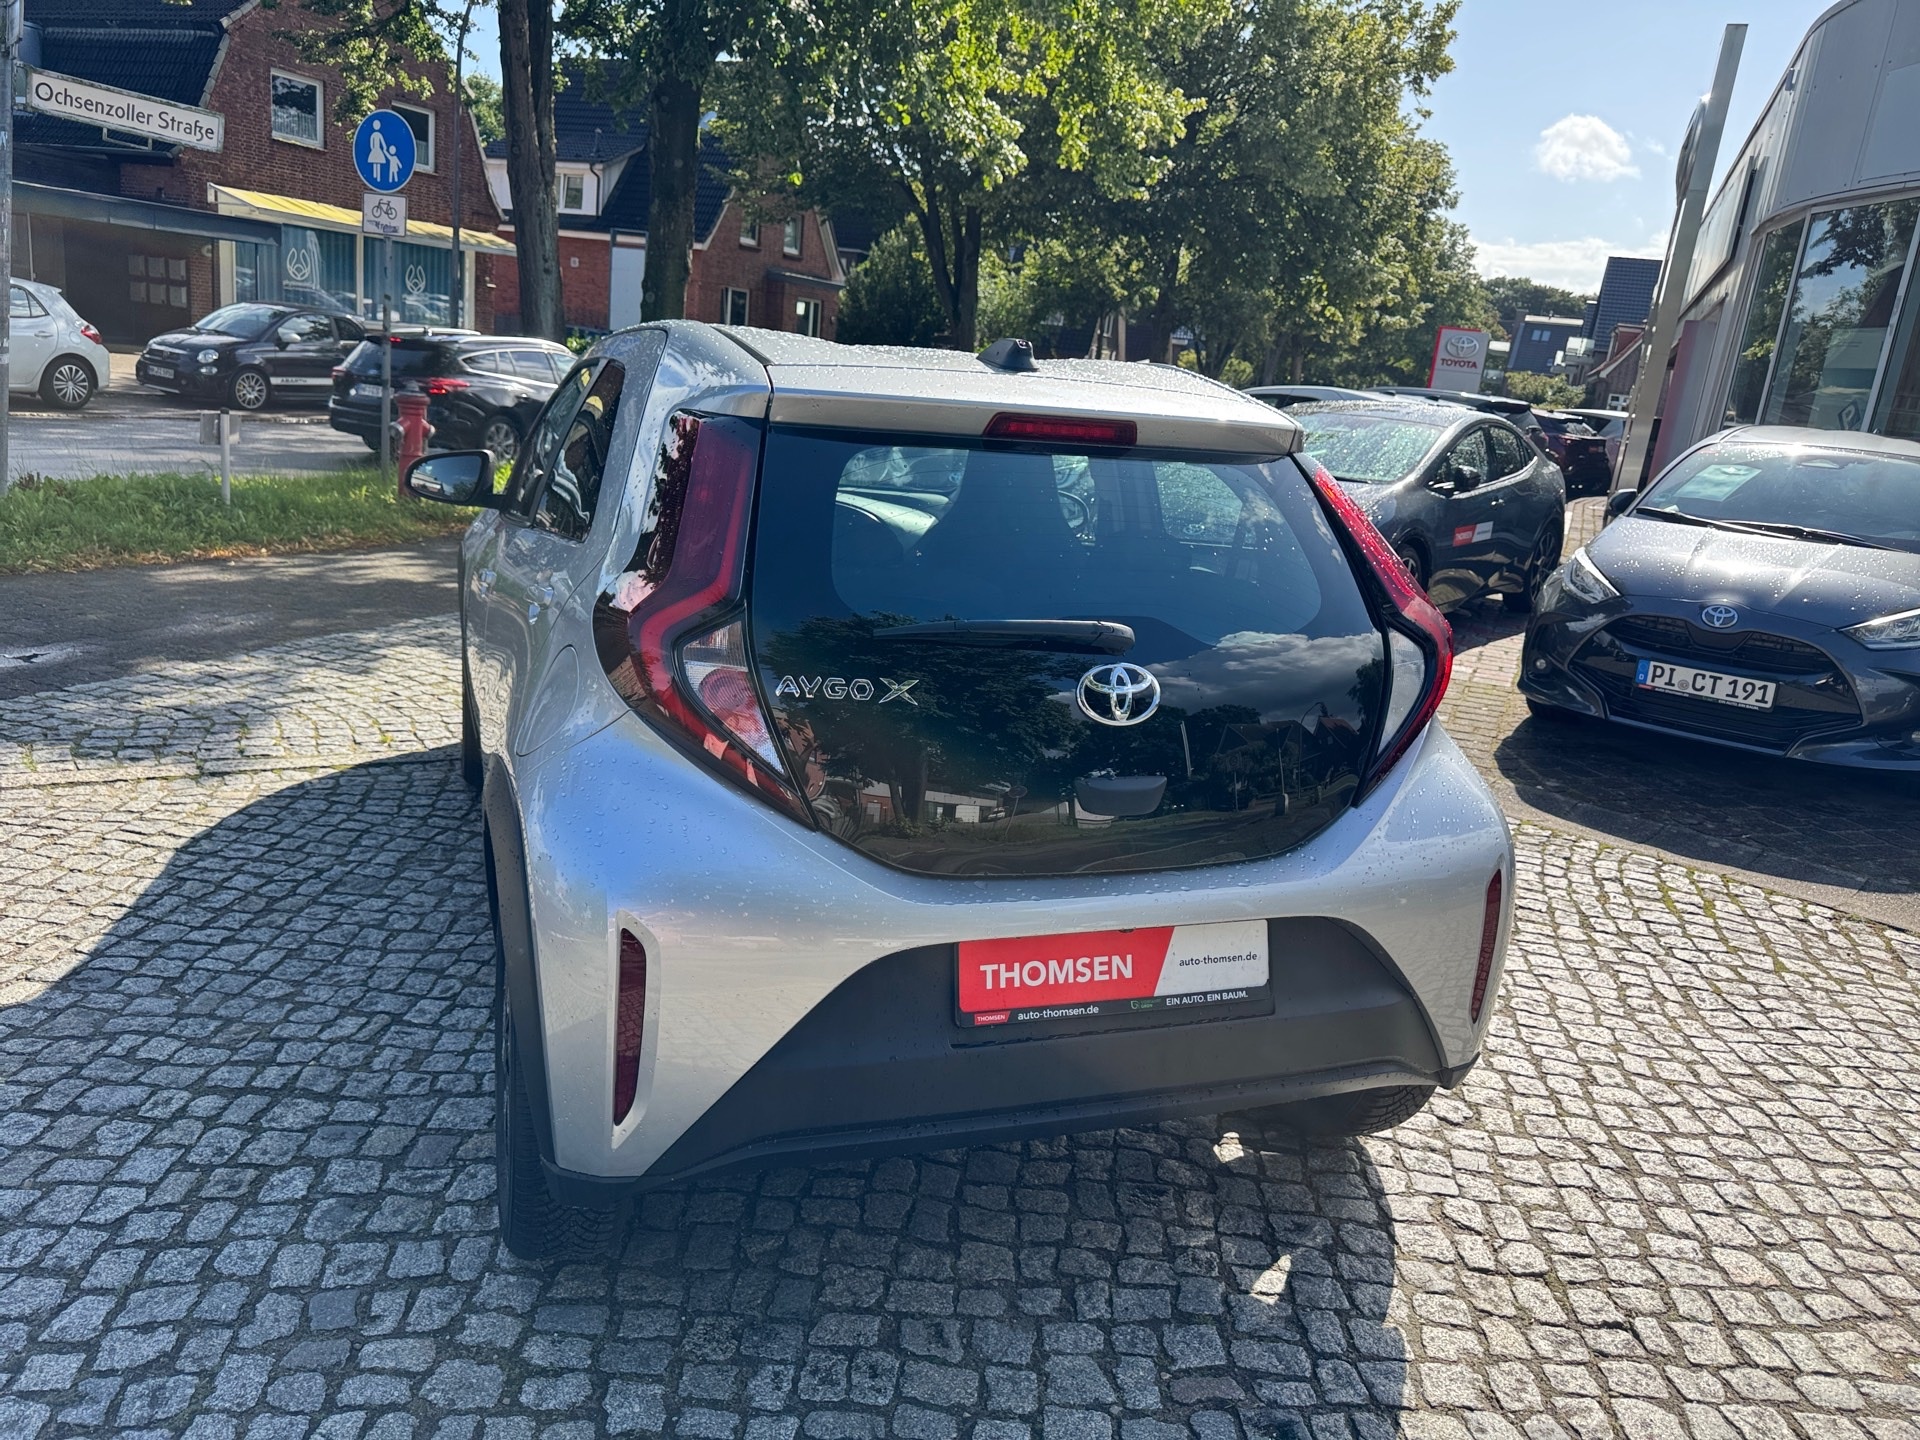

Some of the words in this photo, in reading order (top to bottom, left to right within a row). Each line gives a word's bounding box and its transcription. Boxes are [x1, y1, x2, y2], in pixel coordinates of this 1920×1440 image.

[35, 82, 153, 126] Ochsenzoller
[158, 111, 215, 141] Straße
[1441, 358, 1477, 369] TOYOTA
[775, 675, 874, 700] AYGO
[878, 677, 919, 706] X
[1651, 665, 1676, 687] PI
[1691, 673, 1723, 695] CT
[1725, 679, 1768, 704] 191
[1179, 951, 1258, 967] auto-thomsen.de
[979, 954, 1133, 989] THOMSEN
[1166, 998, 1180, 1006] EIN
[1181, 995, 1205, 1004] AUTO.
[1207, 993, 1220, 1001] EIN
[1222, 991, 1248, 1000] BAUM.
[976, 1014, 1006, 1022] THOMSEN
[1018, 1005, 1099, 1020] auto-thomsen.de
